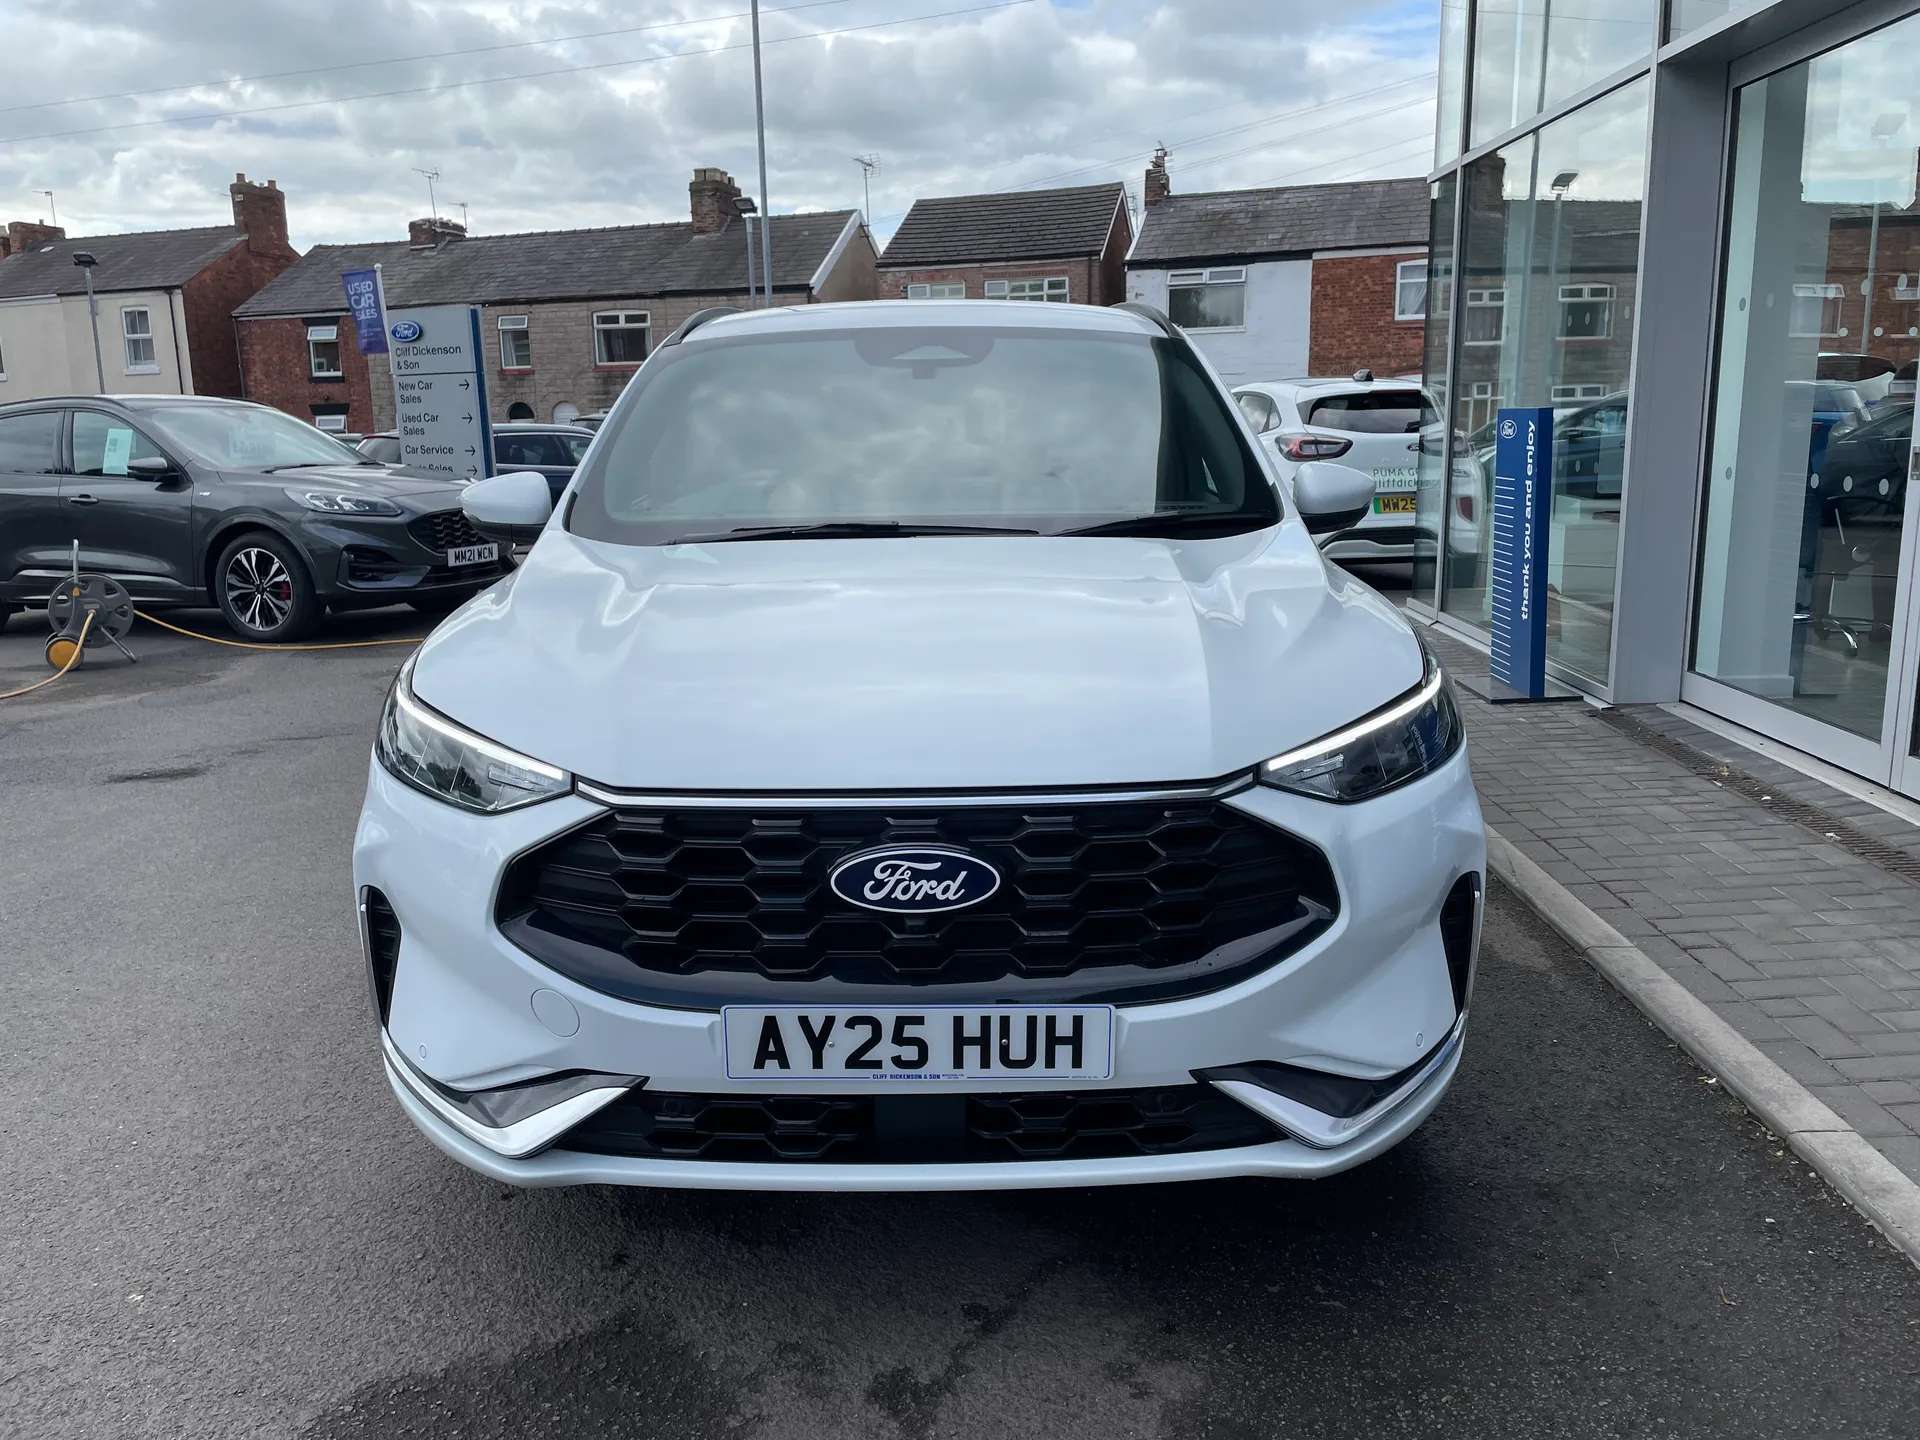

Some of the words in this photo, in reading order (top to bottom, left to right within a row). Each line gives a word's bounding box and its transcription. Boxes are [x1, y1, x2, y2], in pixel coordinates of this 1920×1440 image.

[348, 281, 373, 295] USED
[351, 293, 375, 309] CAR
[395, 346, 410, 357] Cliff
[412, 345, 462, 356] Dickenson
[397, 360, 402, 370] &
[403, 360, 420, 370] Son
[399, 381, 416, 391] New
[417, 380, 433, 391] Car
[400, 394, 422, 404] Sales
[402, 412, 422, 423] Used
[423, 412, 439, 423] Car
[403, 426, 425, 436] Sales
[405, 445, 419, 455] Car
[420, 445, 454, 455] Service
[1526, 420, 1536, 476] enjoy
[1373, 468, 1403, 477] PUMA
[1382, 498, 1416, 511] MW25
[1525, 480, 1533, 519] and
[1524, 523, 1532, 559] you
[454, 548, 475, 563] MM21
[1521, 563, 1530, 621] thank
[863, 860, 968, 901] Ford
[753, 1015, 929, 1070] AY25
[952, 1015, 1084, 1070] HUH
